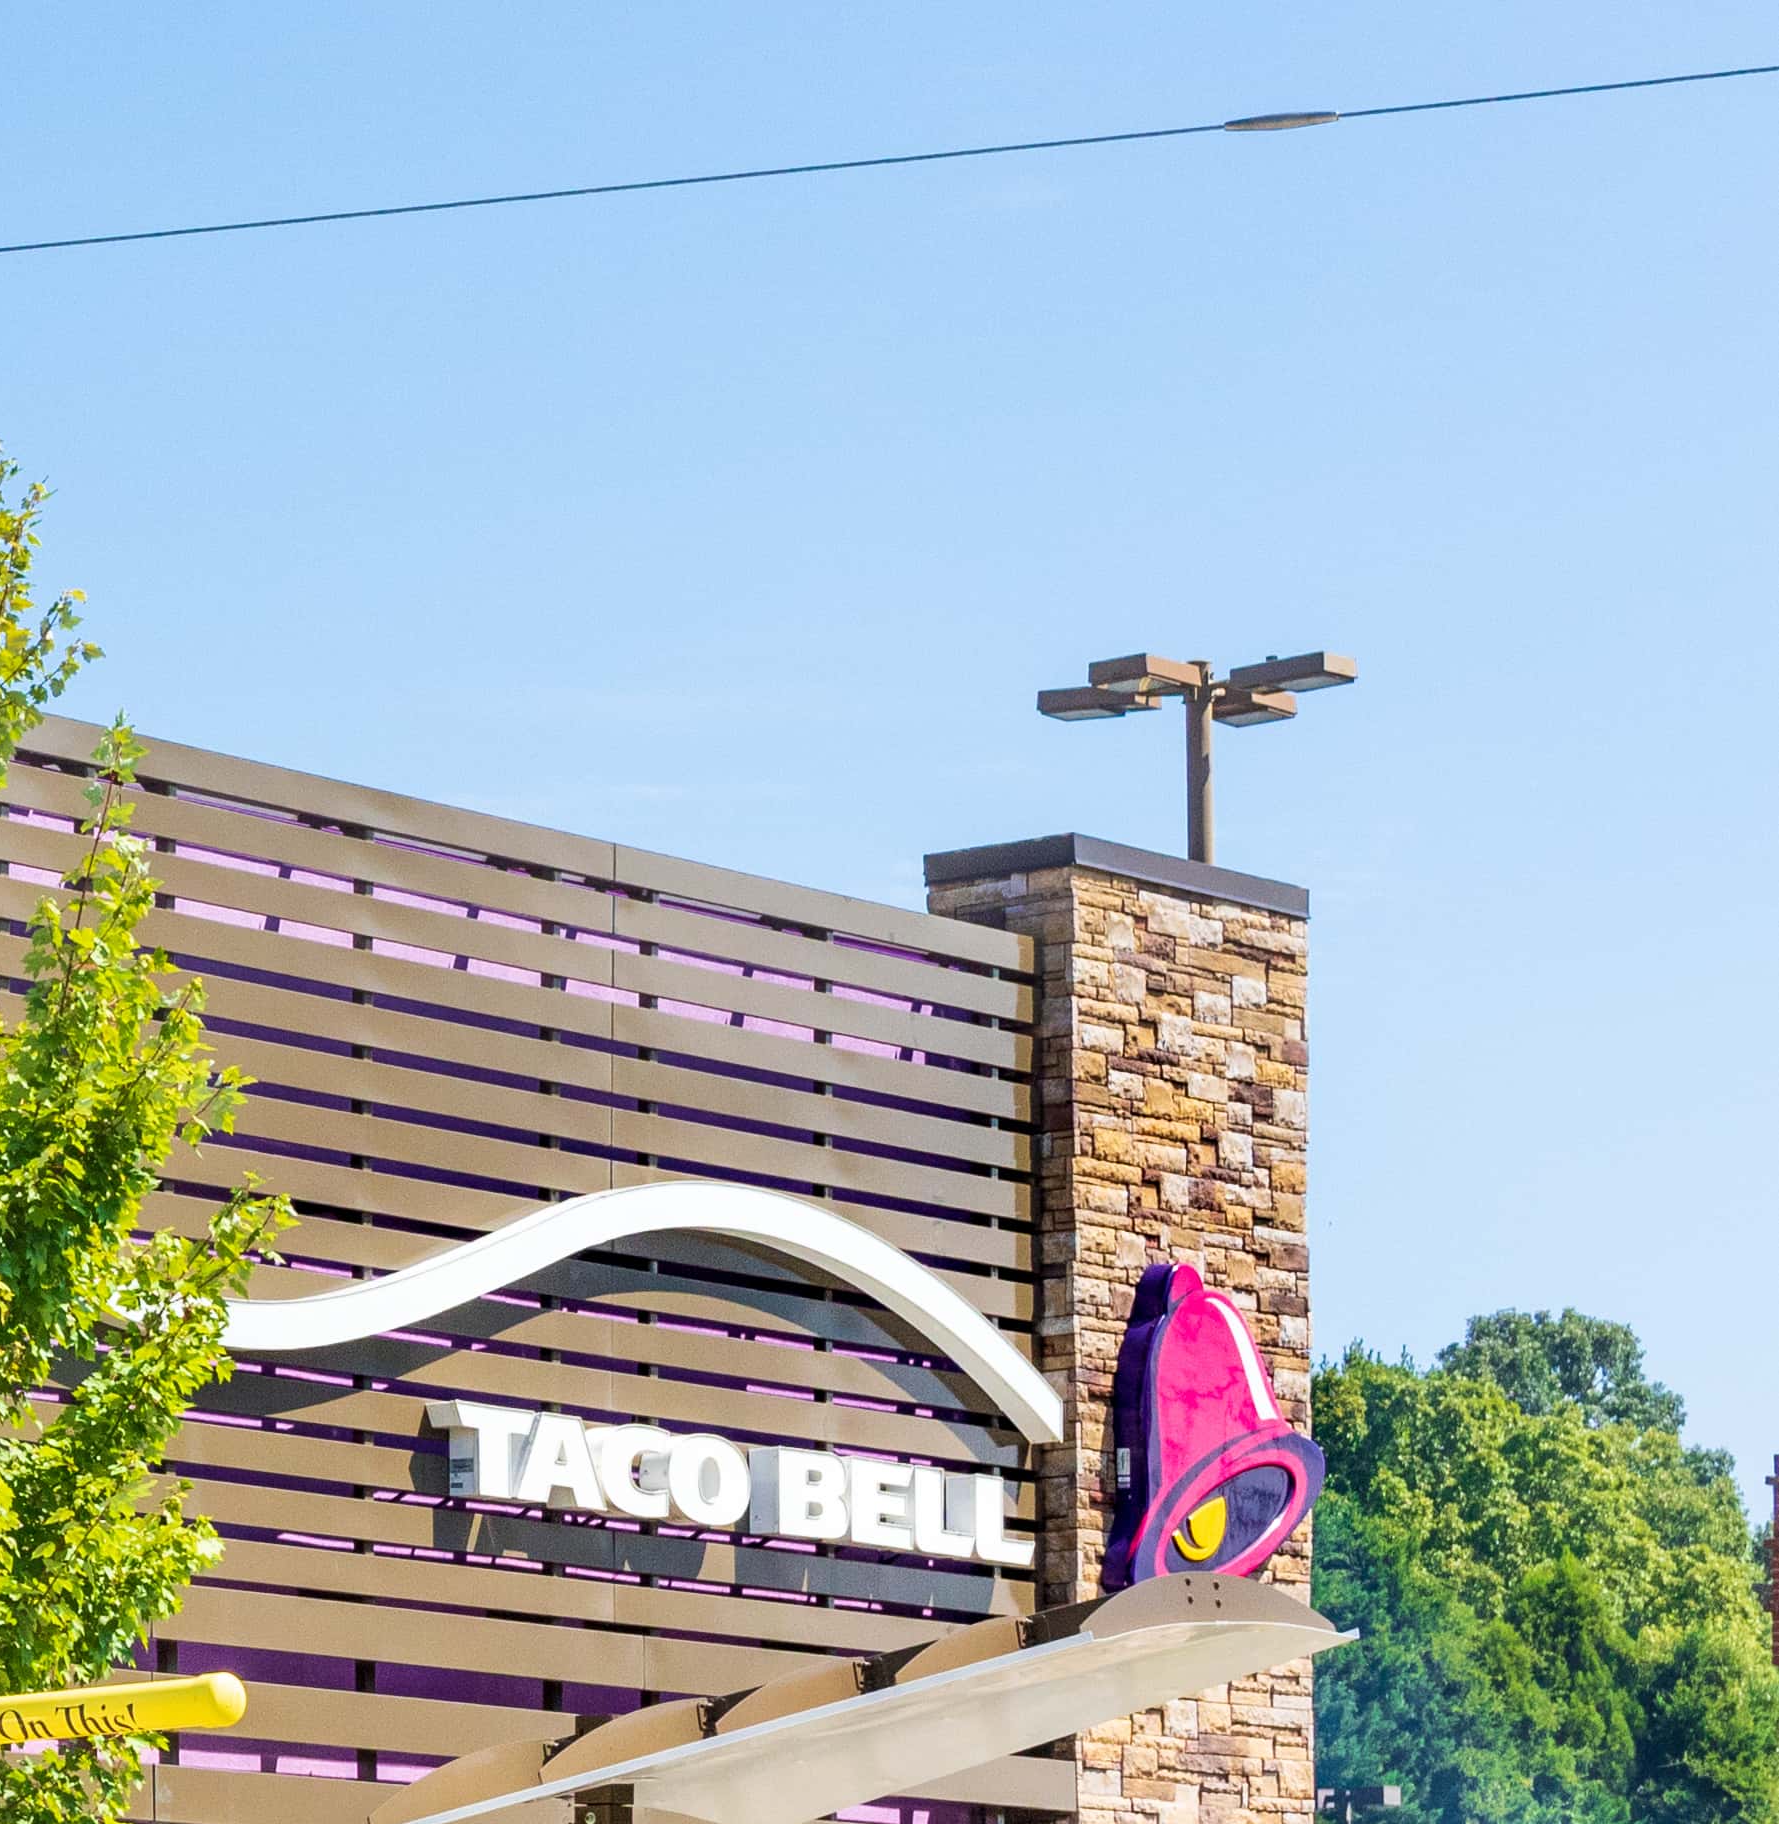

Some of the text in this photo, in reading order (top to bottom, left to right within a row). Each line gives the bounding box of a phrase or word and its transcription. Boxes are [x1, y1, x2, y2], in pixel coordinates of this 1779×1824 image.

[426, 1399, 1036, 1568] TACO BELL
[55, 1703, 142, 1737] This!
